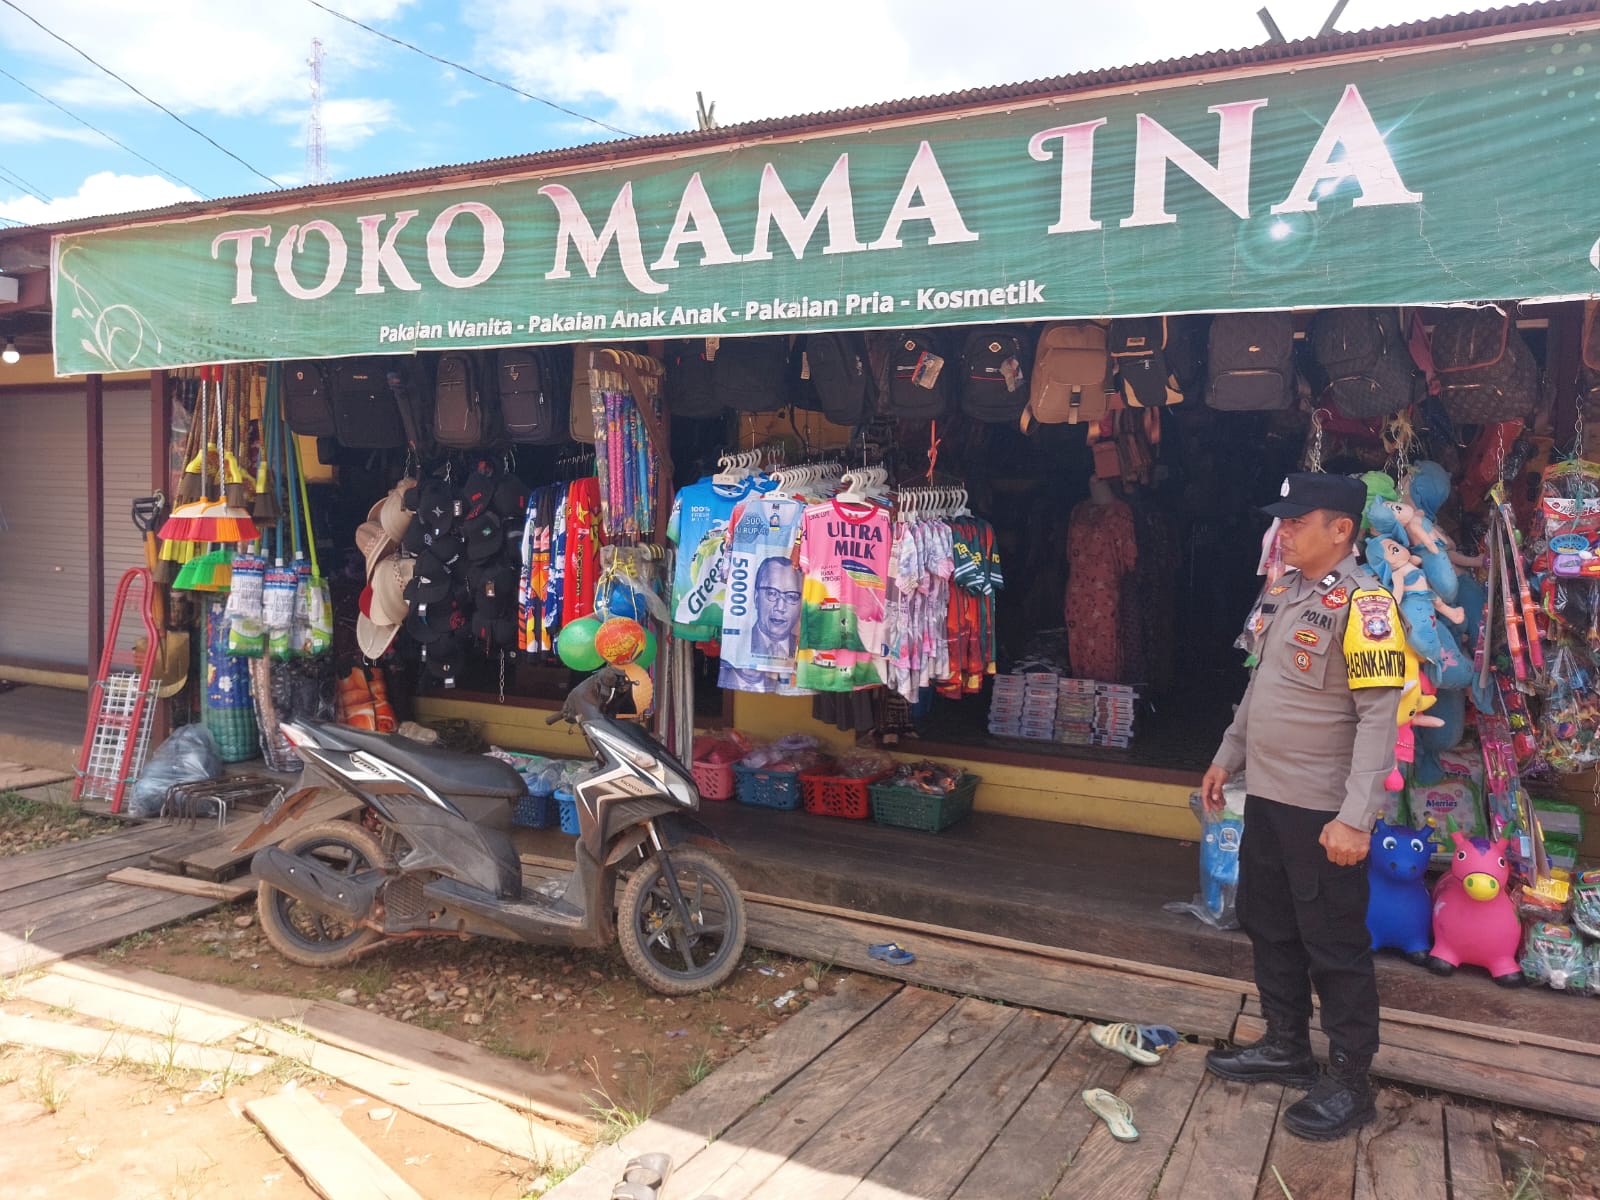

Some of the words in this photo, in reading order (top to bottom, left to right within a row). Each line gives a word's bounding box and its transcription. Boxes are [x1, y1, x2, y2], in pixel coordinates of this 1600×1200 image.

[211, 201, 505, 305] TOKO
[537, 140, 980, 294] MAMA
[1027, 83, 1423, 234] INA
[379, 321, 443, 343] Pakaian
[447, 317, 513, 338] Wanita
[528, 313, 606, 334] Pakaian
[611, 306, 666, 329] Anak
[669, 302, 727, 325] Anak
[745, 296, 838, 320] Pakaian
[846, 290, 894, 315] Pria
[916, 279, 1046, 310] Kosmetik
[827, 521, 882, 543] ULTRA
[834, 540, 875, 560] MILK
[729, 557, 749, 617] 50000
[1301, 609, 1332, 630] POLRI
[1426, 800, 1457, 808] Merries
